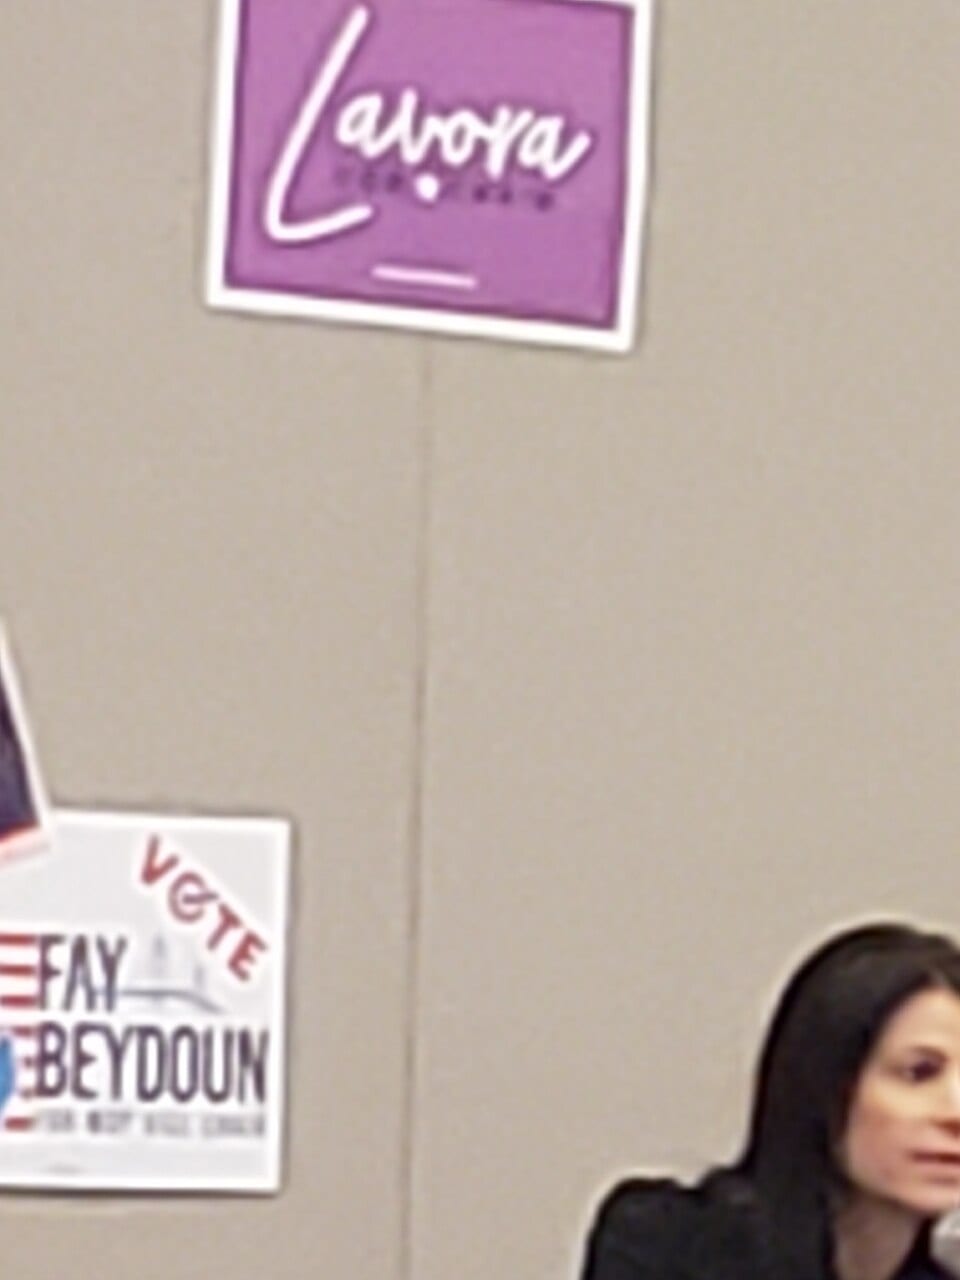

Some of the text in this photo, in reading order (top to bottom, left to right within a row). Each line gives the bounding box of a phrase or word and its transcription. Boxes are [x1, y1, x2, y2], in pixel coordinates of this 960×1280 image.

[264, 5, 592, 242] Lavora
[140, 834, 268, 981] VOTE
[39, 934, 127, 1012] FAY
[37, 1021, 269, 1105] BEYDOUN
